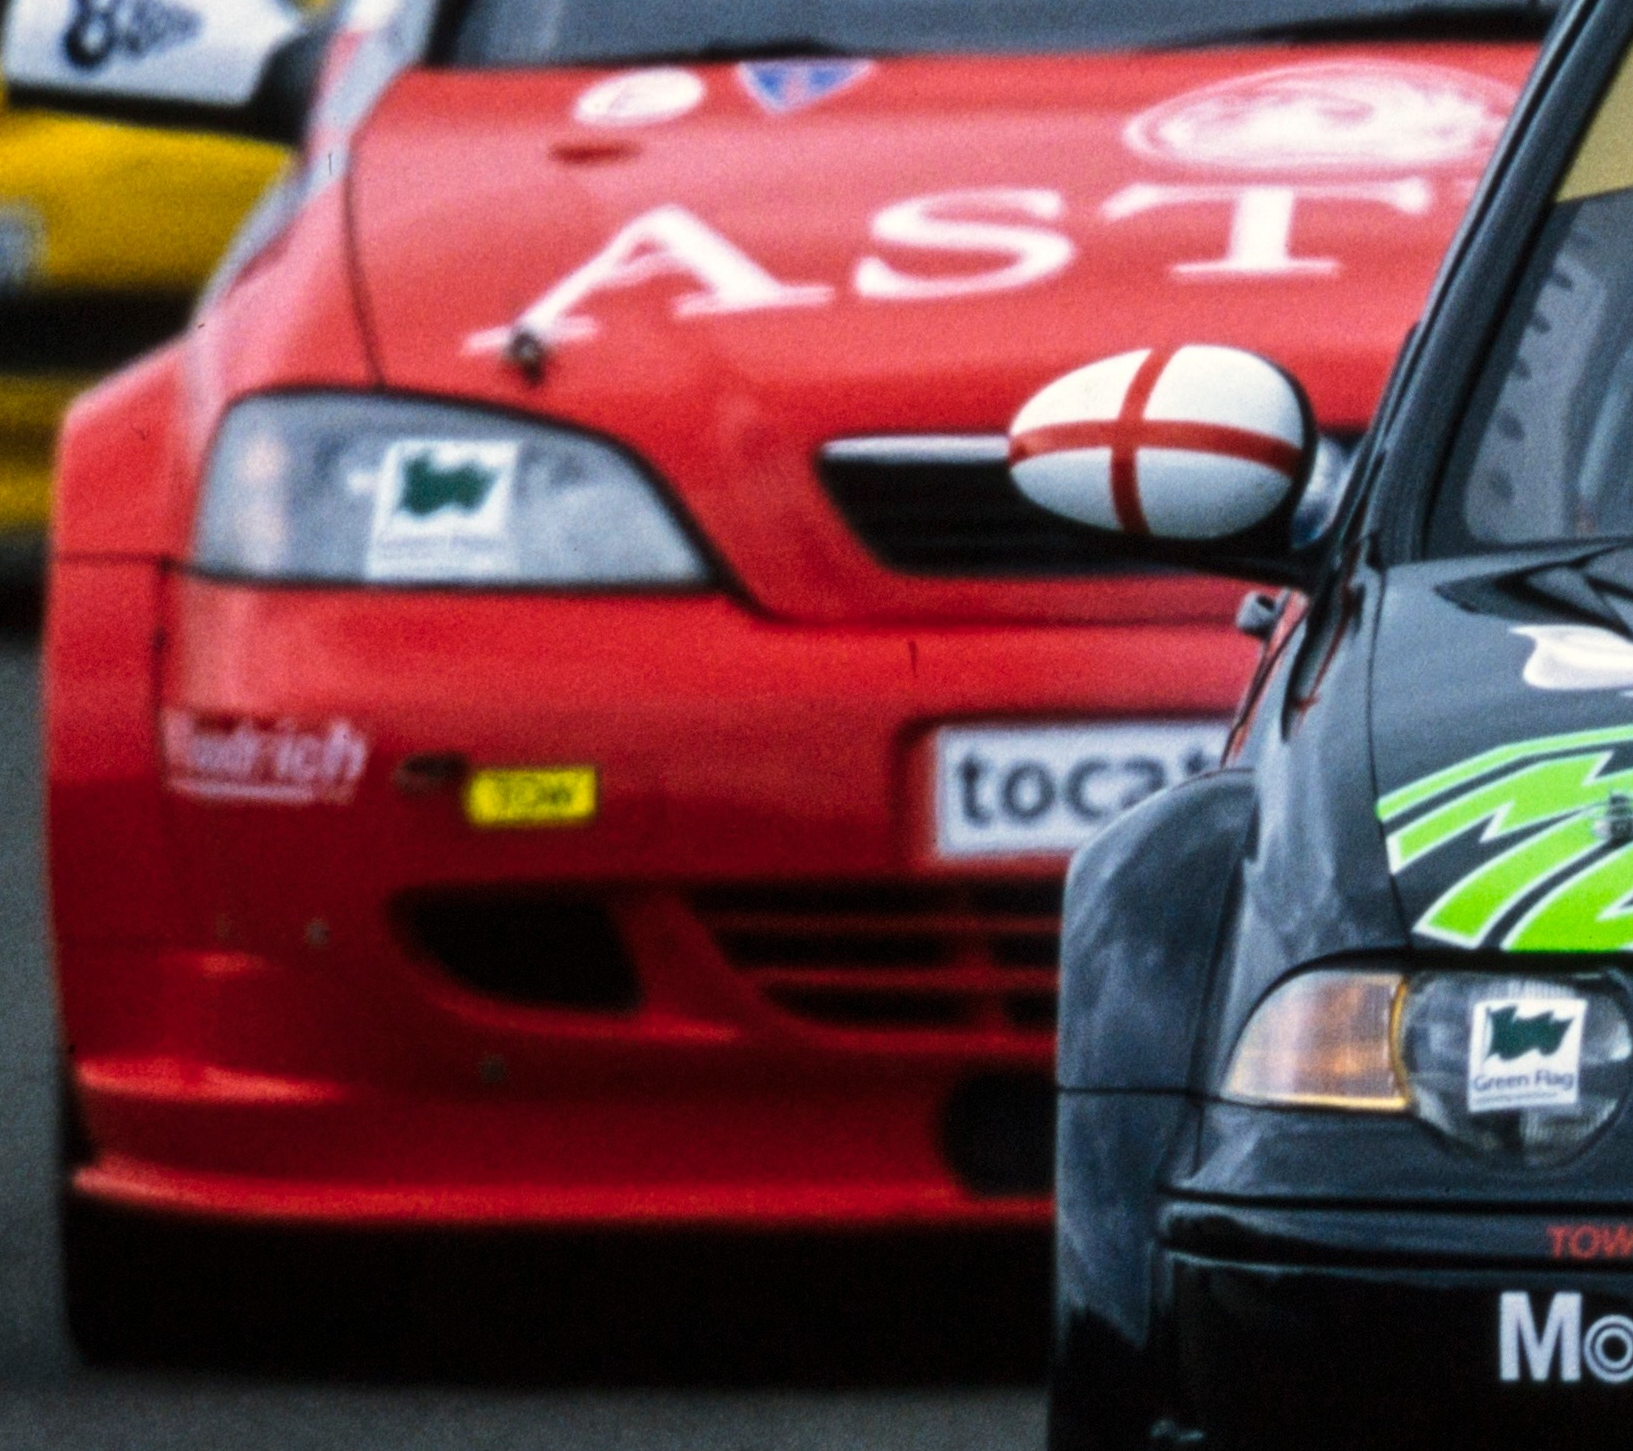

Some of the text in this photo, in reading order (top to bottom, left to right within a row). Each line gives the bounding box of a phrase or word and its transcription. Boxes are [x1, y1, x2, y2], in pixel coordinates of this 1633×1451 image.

[461, 194, 1476, 359] AST
[1473, 1069, 1574, 1091] Green Flag
